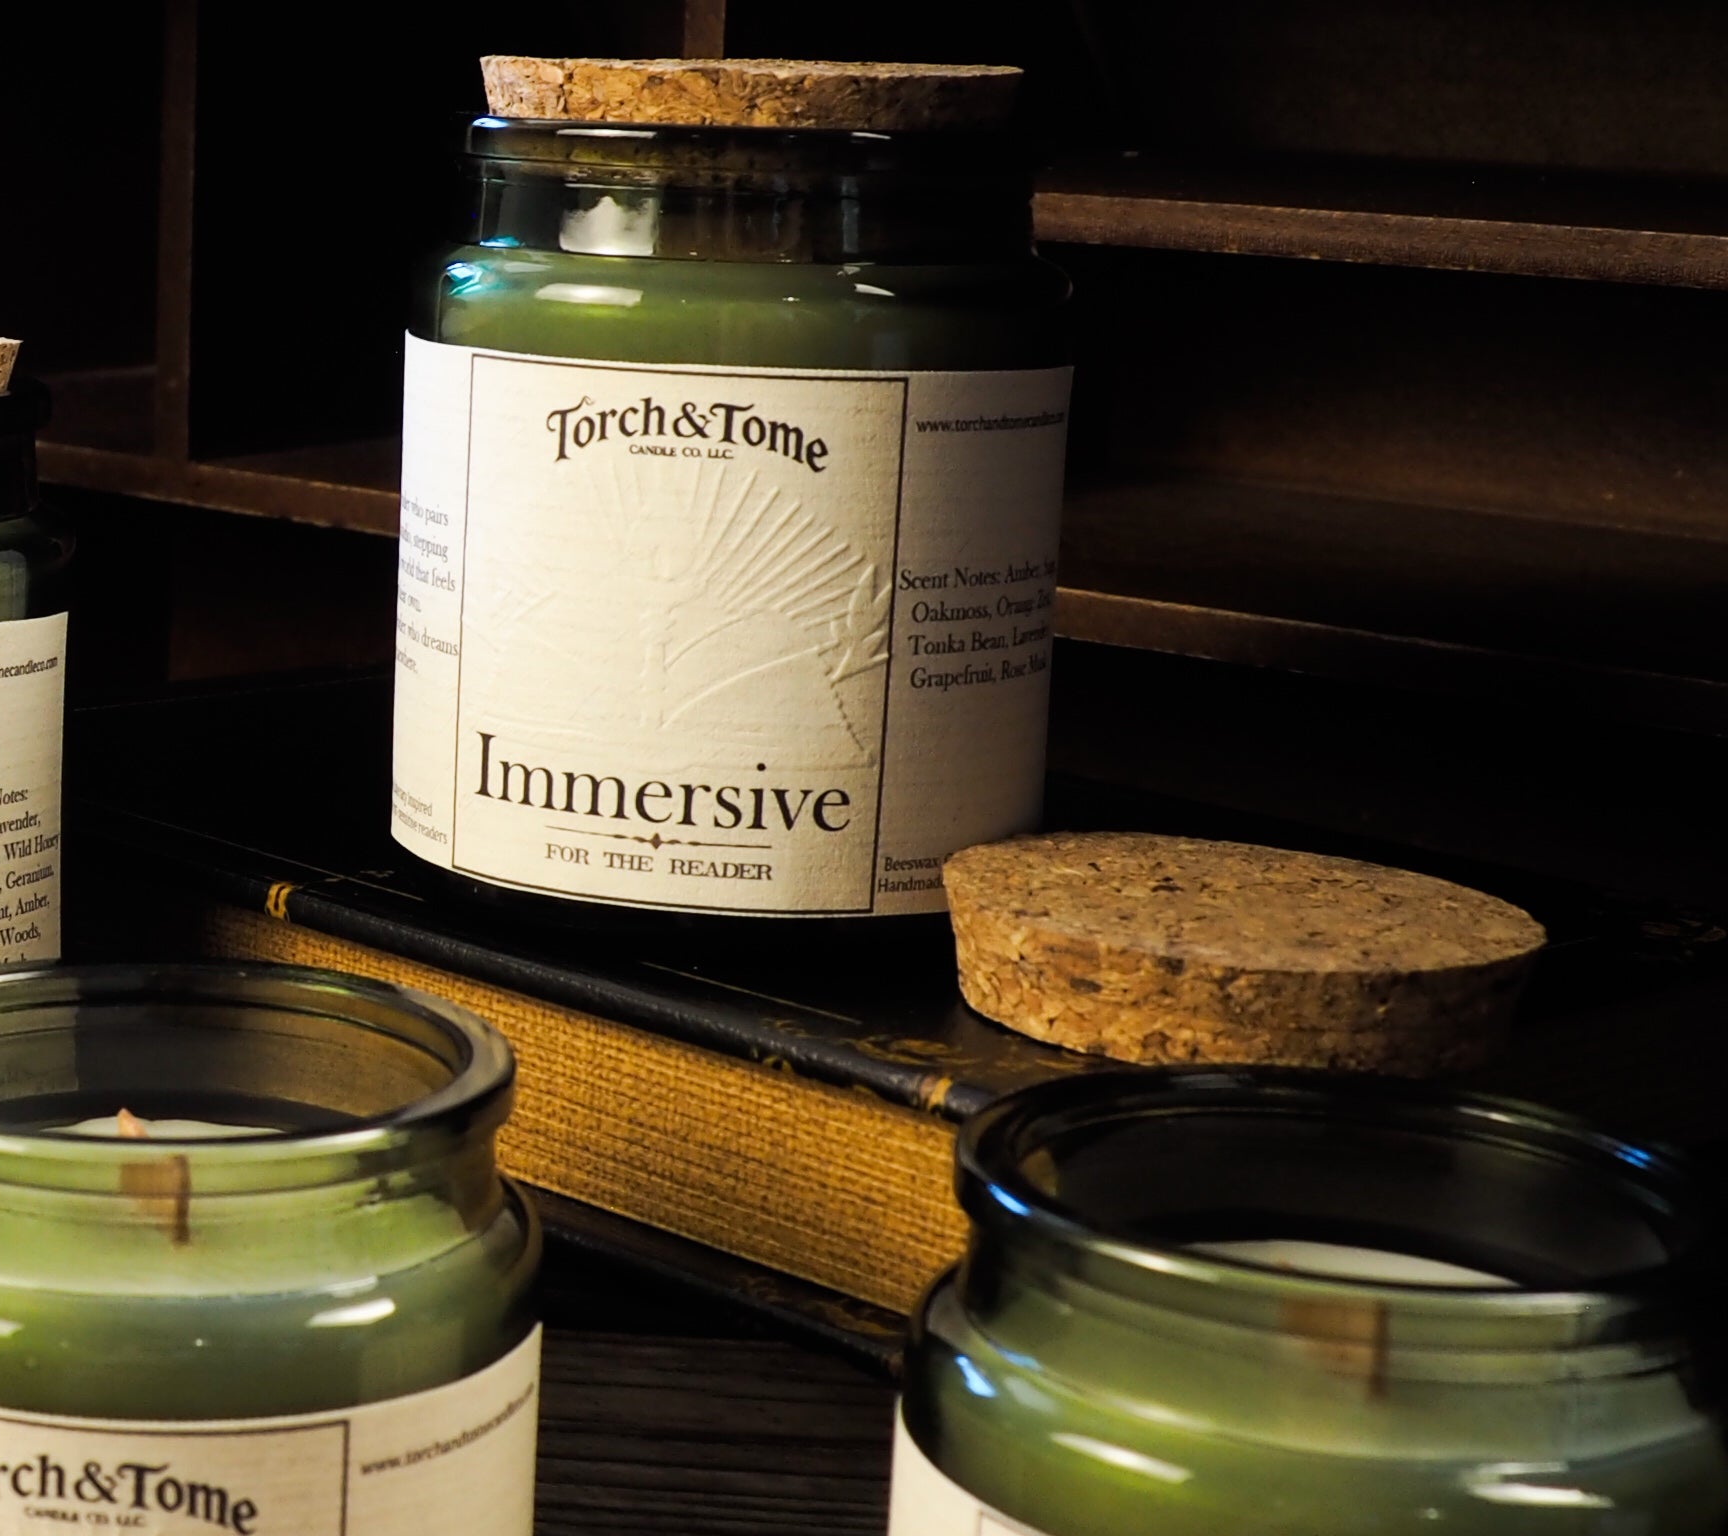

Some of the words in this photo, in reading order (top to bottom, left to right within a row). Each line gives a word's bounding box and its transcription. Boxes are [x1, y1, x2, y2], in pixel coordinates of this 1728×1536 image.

[628, 443, 678, 458] CANDLE
[424, 503, 450, 527] pairs
[431, 567, 457, 593] feels
[897, 567, 949, 592] Scent
[952, 566, 1002, 589] Notes:
[910, 600, 993, 625] Oakmoss,
[420, 626, 460, 657] dreams
[906, 632, 966, 657] Tonka
[909, 661, 997, 693] Grapefruit,
[999, 659, 1026, 682] Rose
[473, 729, 853, 834] Immersive
[2, 837, 32, 862] Wild
[544, 841, 591, 866] FOR
[602, 850, 655, 874] THE
[667, 857, 774, 882] READER
